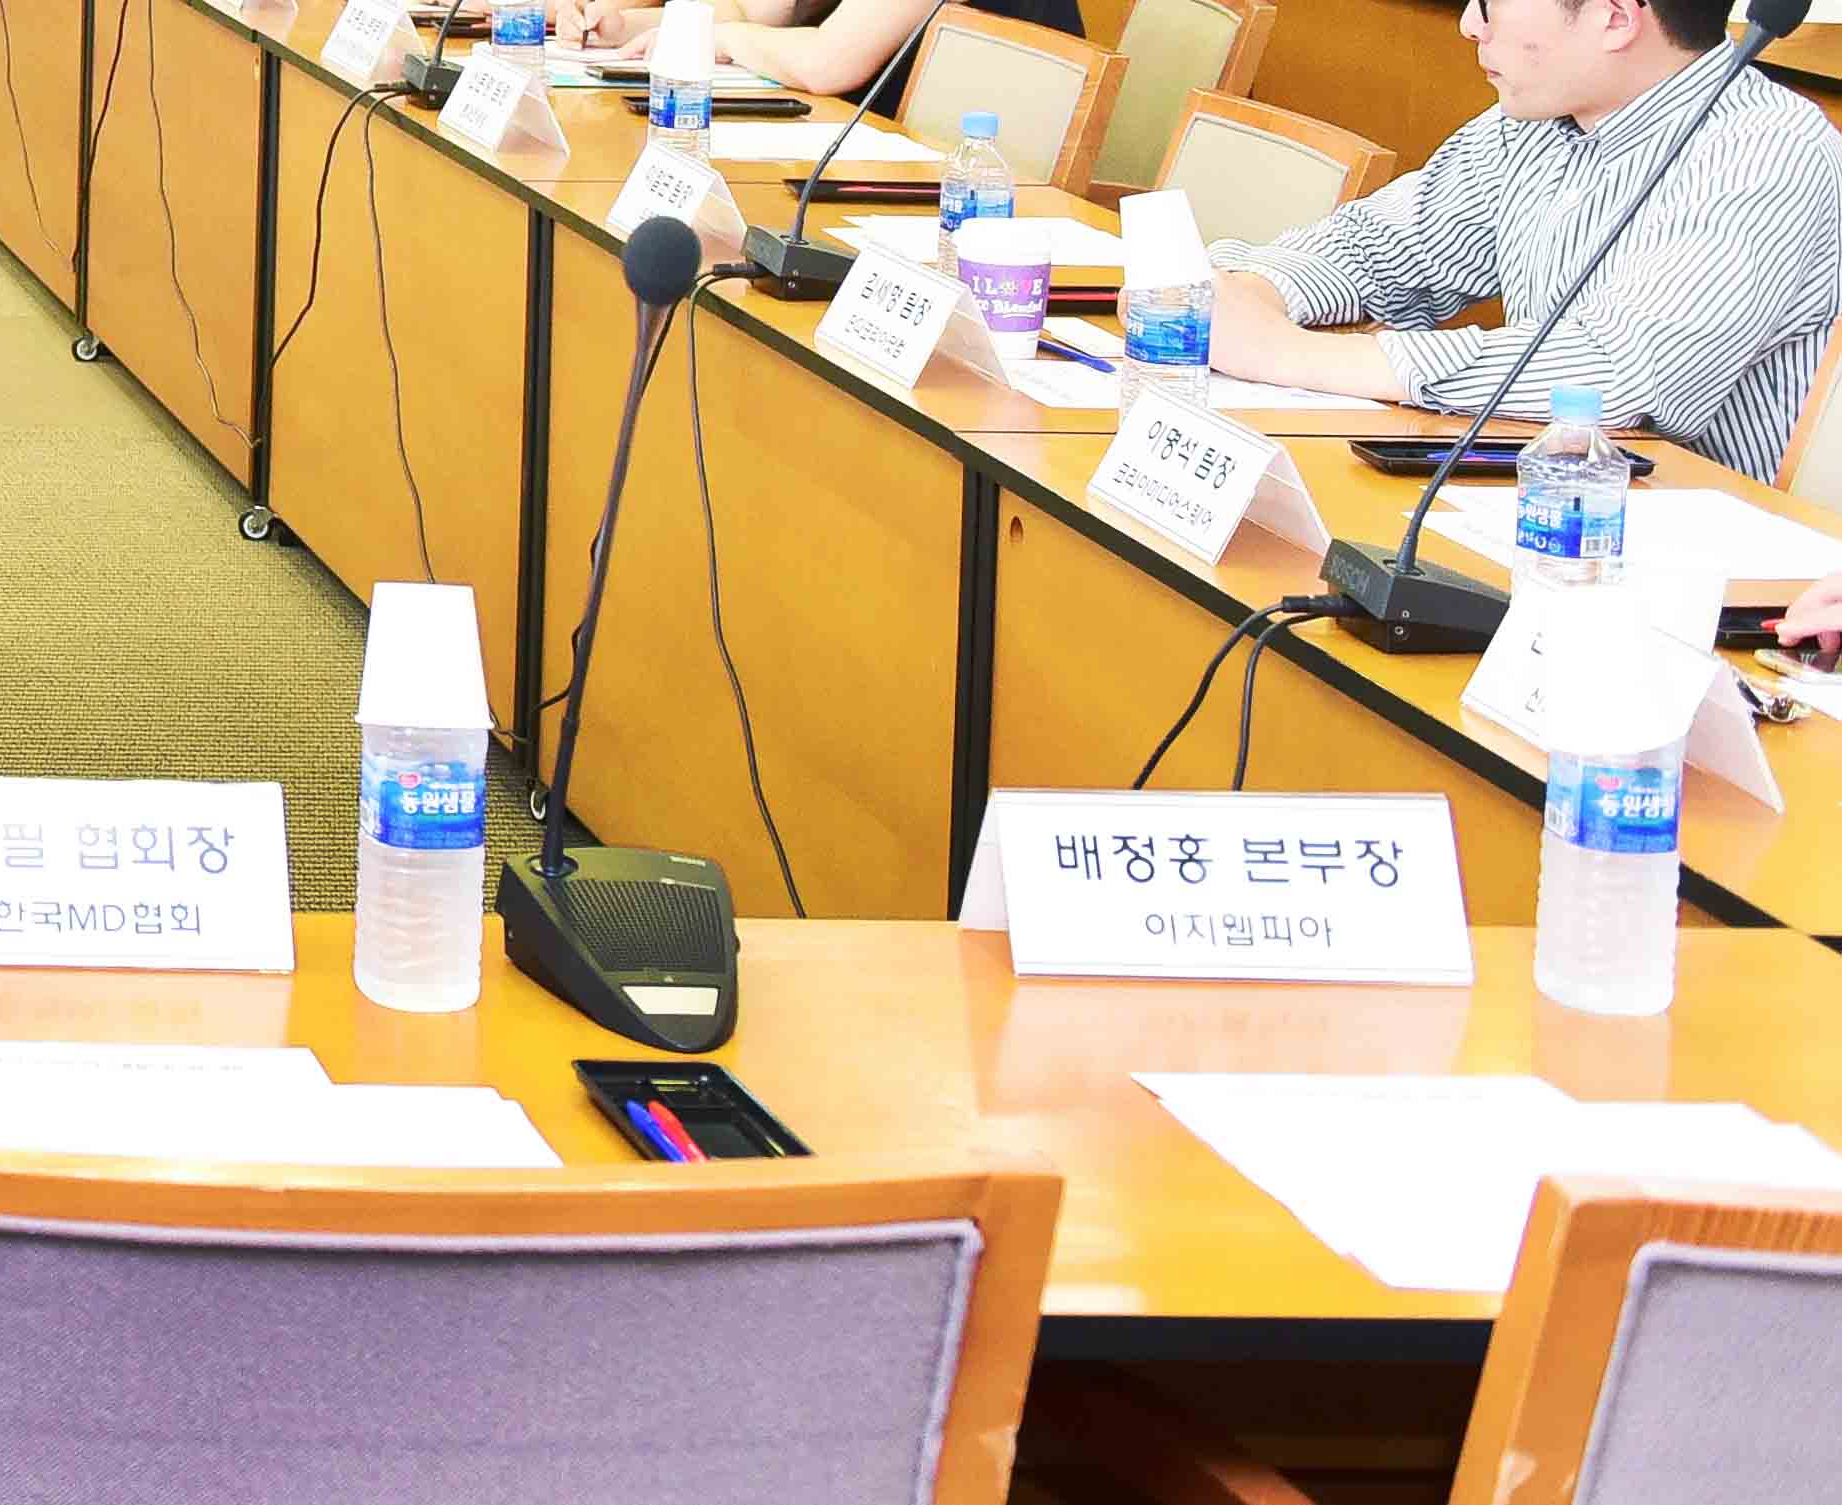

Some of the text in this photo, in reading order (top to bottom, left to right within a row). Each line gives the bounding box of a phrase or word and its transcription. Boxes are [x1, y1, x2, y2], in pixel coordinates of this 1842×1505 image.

[899, 292, 932, 327] 팀장
[1193, 447, 1236, 490] 팀장
[76, 824, 236, 874] 협회장
[1055, 834, 1404, 888] 배정홍 본부장
[1145, 912, 1332, 949] 이지웹피아
